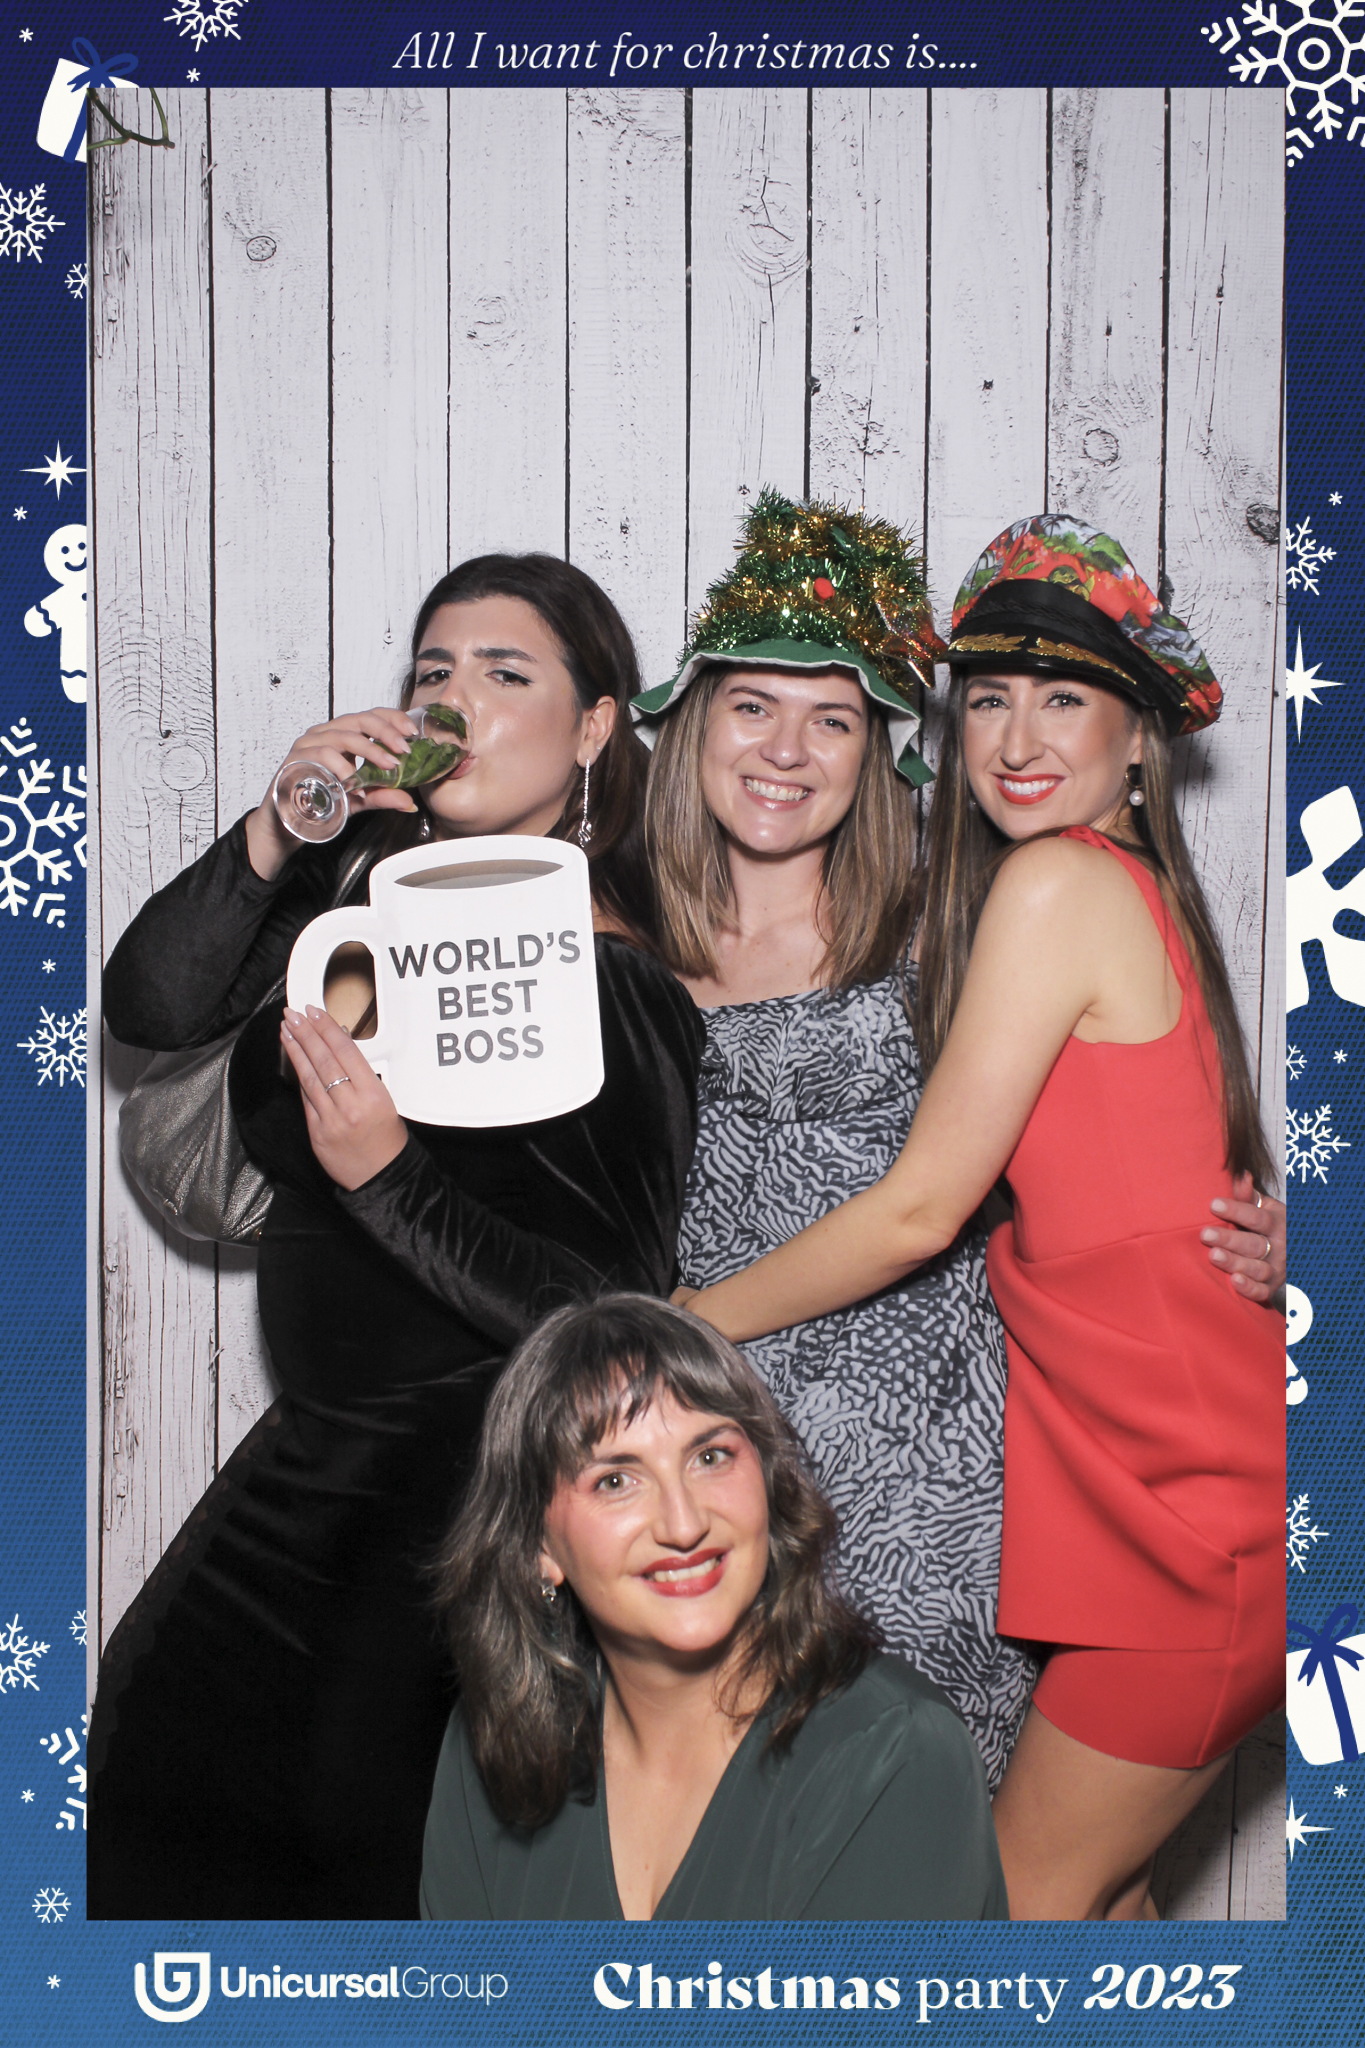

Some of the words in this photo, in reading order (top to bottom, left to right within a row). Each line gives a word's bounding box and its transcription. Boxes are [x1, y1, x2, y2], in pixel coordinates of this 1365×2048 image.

[388, 929, 581, 980] WORLD'S
[437, 978, 538, 1021] BEST
[436, 1024, 544, 1067] BOSS
